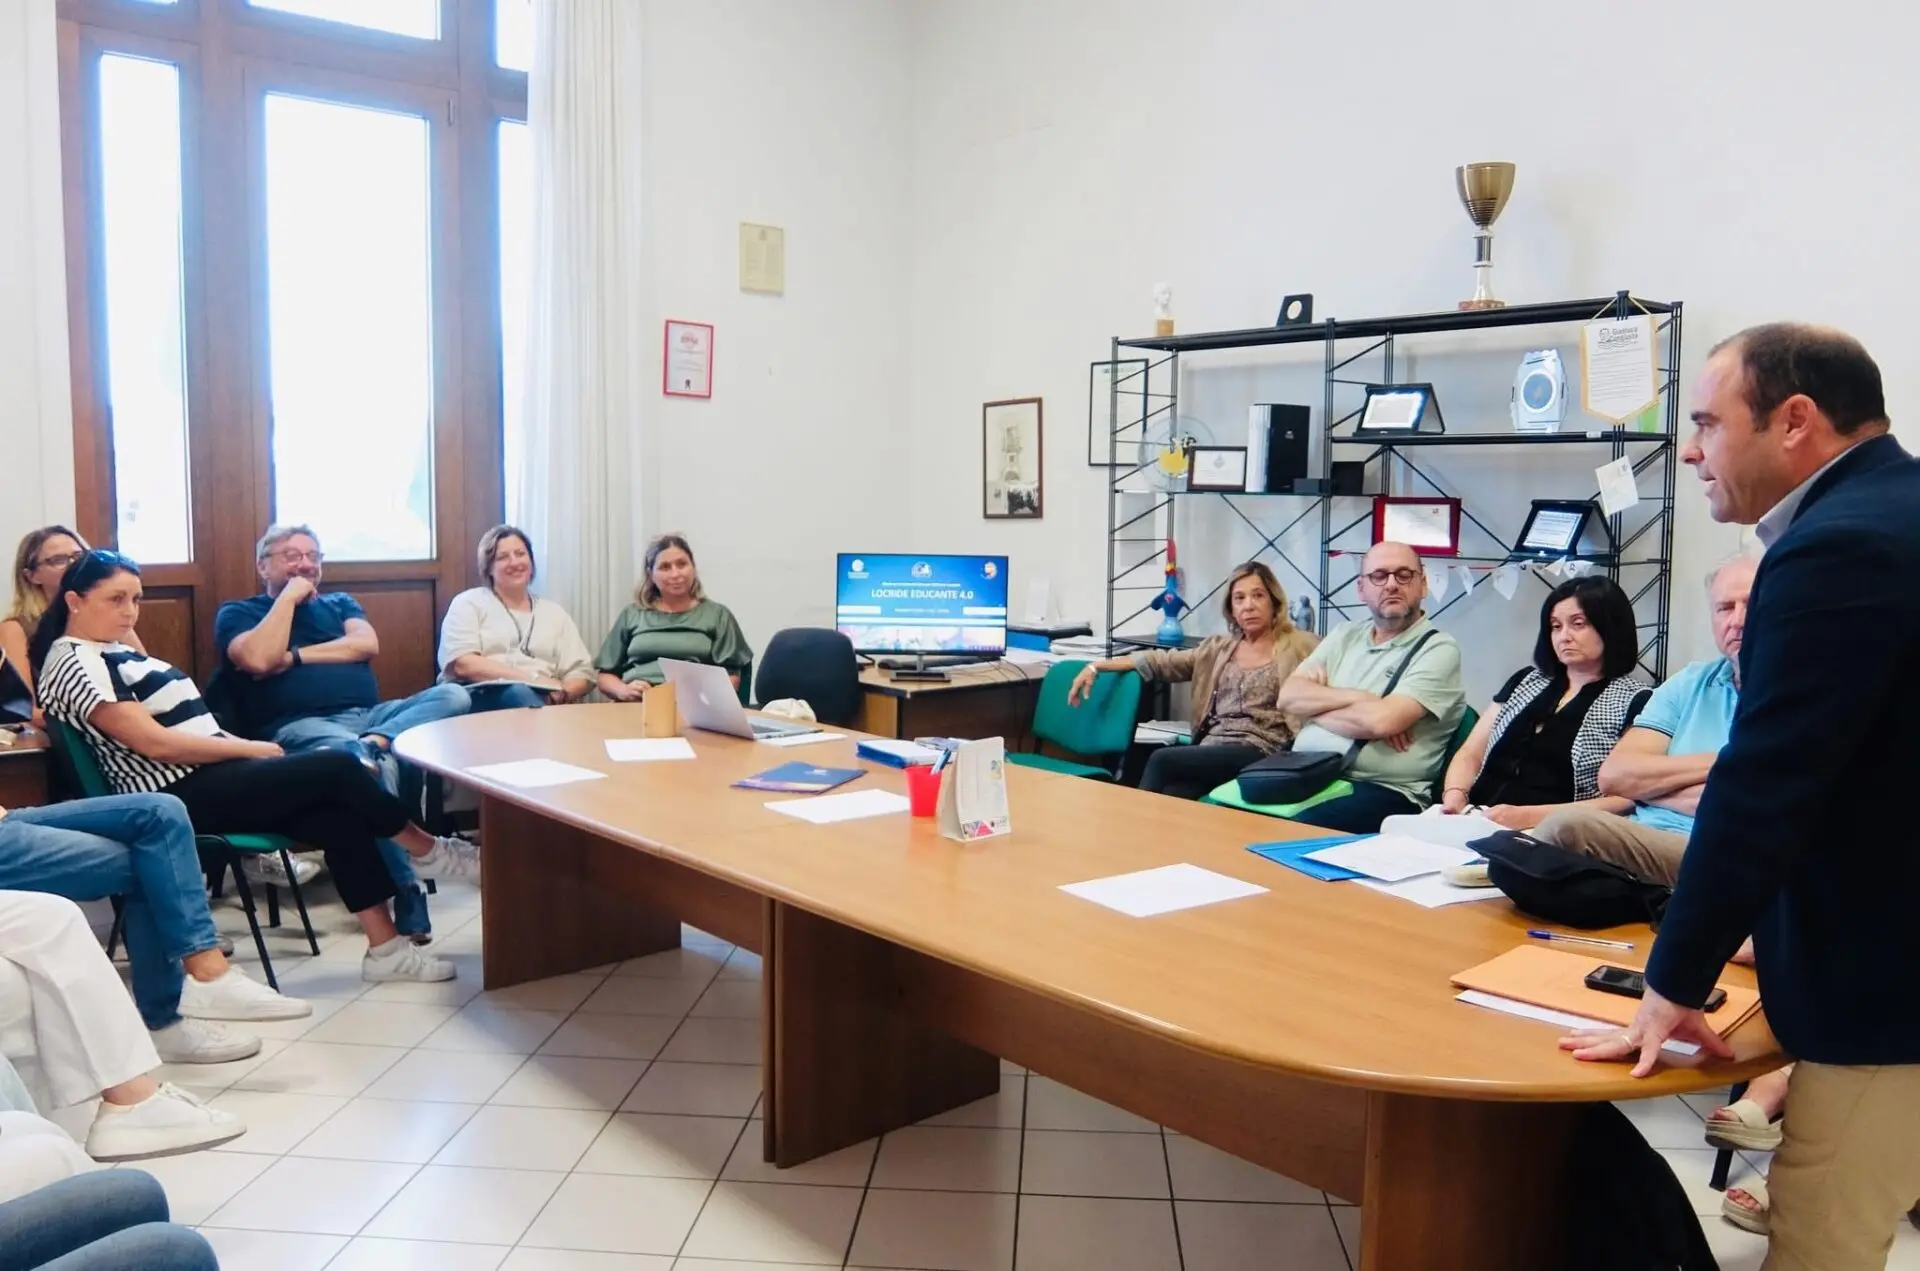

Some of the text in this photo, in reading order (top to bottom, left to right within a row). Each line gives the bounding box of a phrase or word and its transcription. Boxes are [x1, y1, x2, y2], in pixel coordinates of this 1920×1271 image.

[871, 589, 974, 599] LOCRIDE EDUCANTE 4.0
